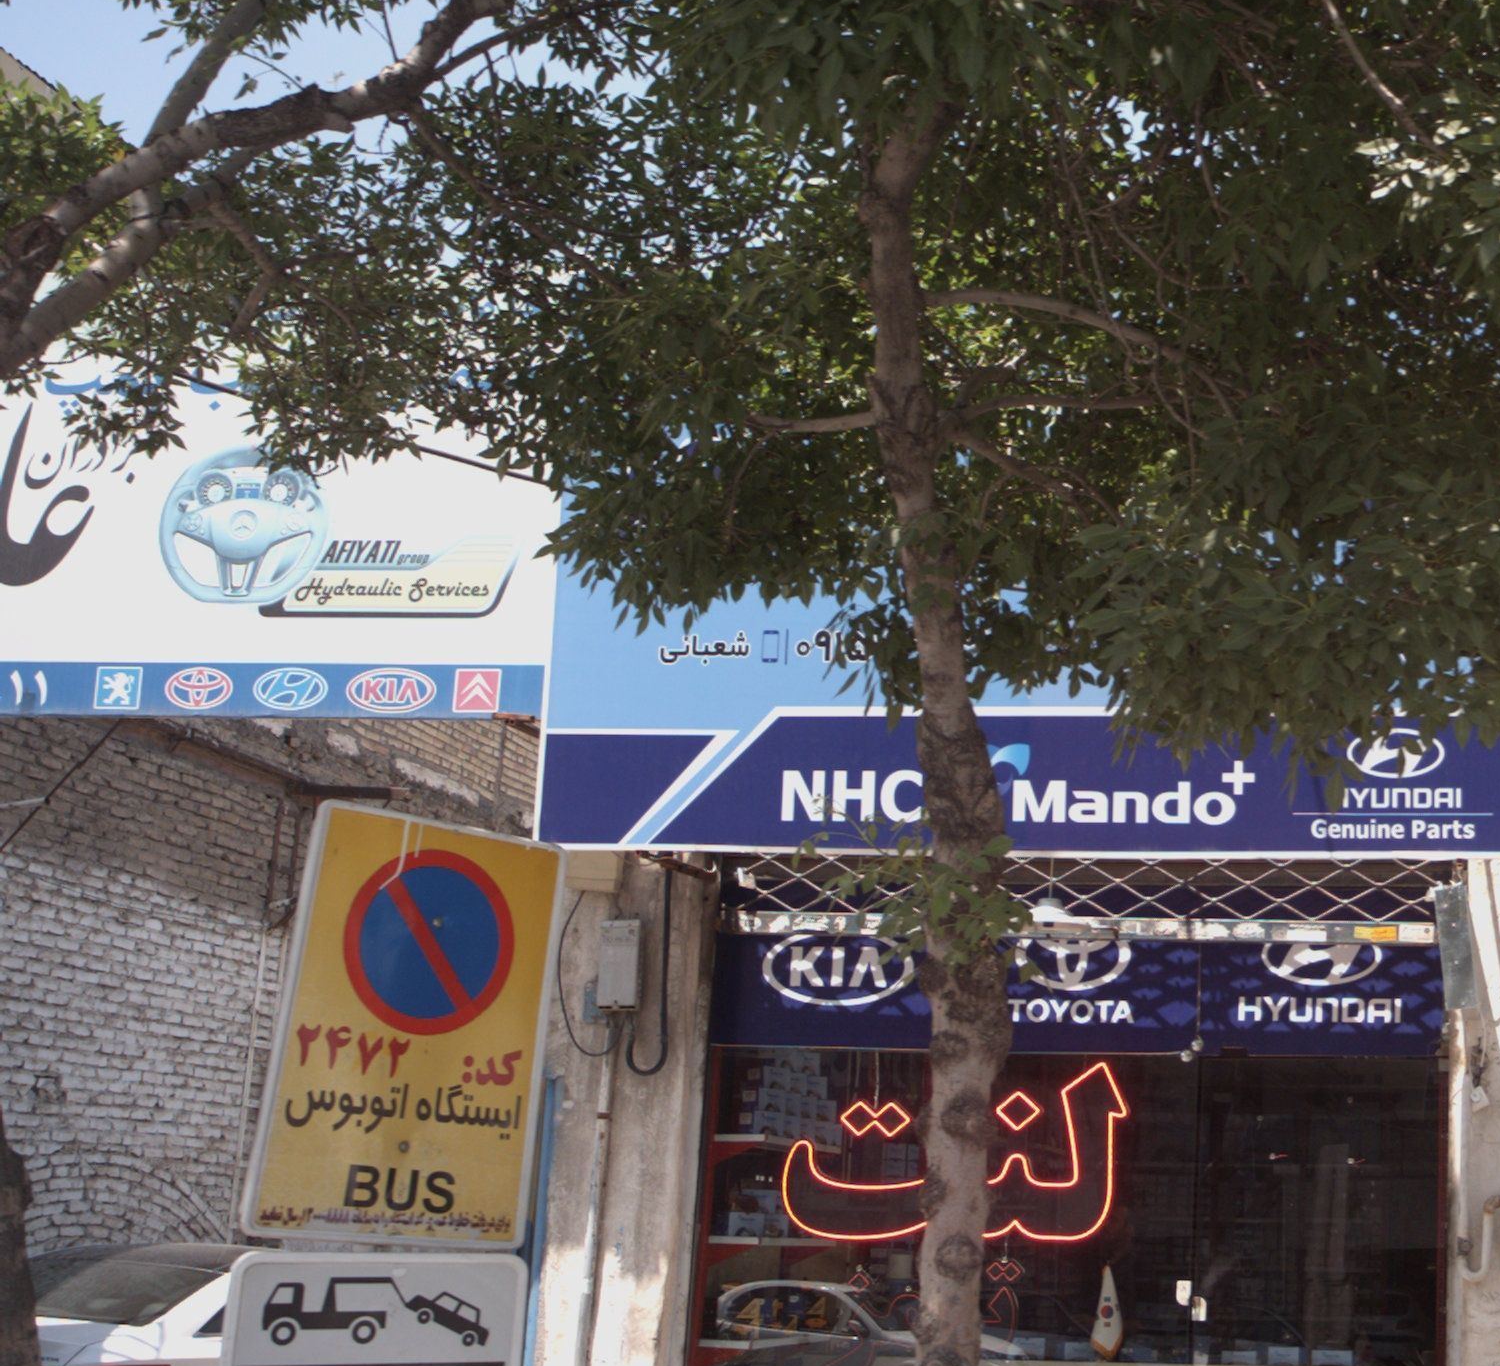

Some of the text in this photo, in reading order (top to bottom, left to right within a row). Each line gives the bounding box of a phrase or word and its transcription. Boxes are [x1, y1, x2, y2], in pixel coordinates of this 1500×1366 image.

[321, 539, 430, 566] AFIYATI group
[294, 577, 490, 606] Hydraulic Services
[659, 632, 749, 664] شعبانی
[362, 678, 420, 704] KIA
[1310, 817, 1476, 840] Genuine Parts
[788, 945, 889, 988] KIA
[1008, 995, 1402, 1024] TOYOTA HYUNDAI
[296, 1023, 411, 1078] ۲۴۷۲
[285, 1082, 522, 1140] ایستگاه اتوبوس
[343, 1164, 456, 1214] BUS
